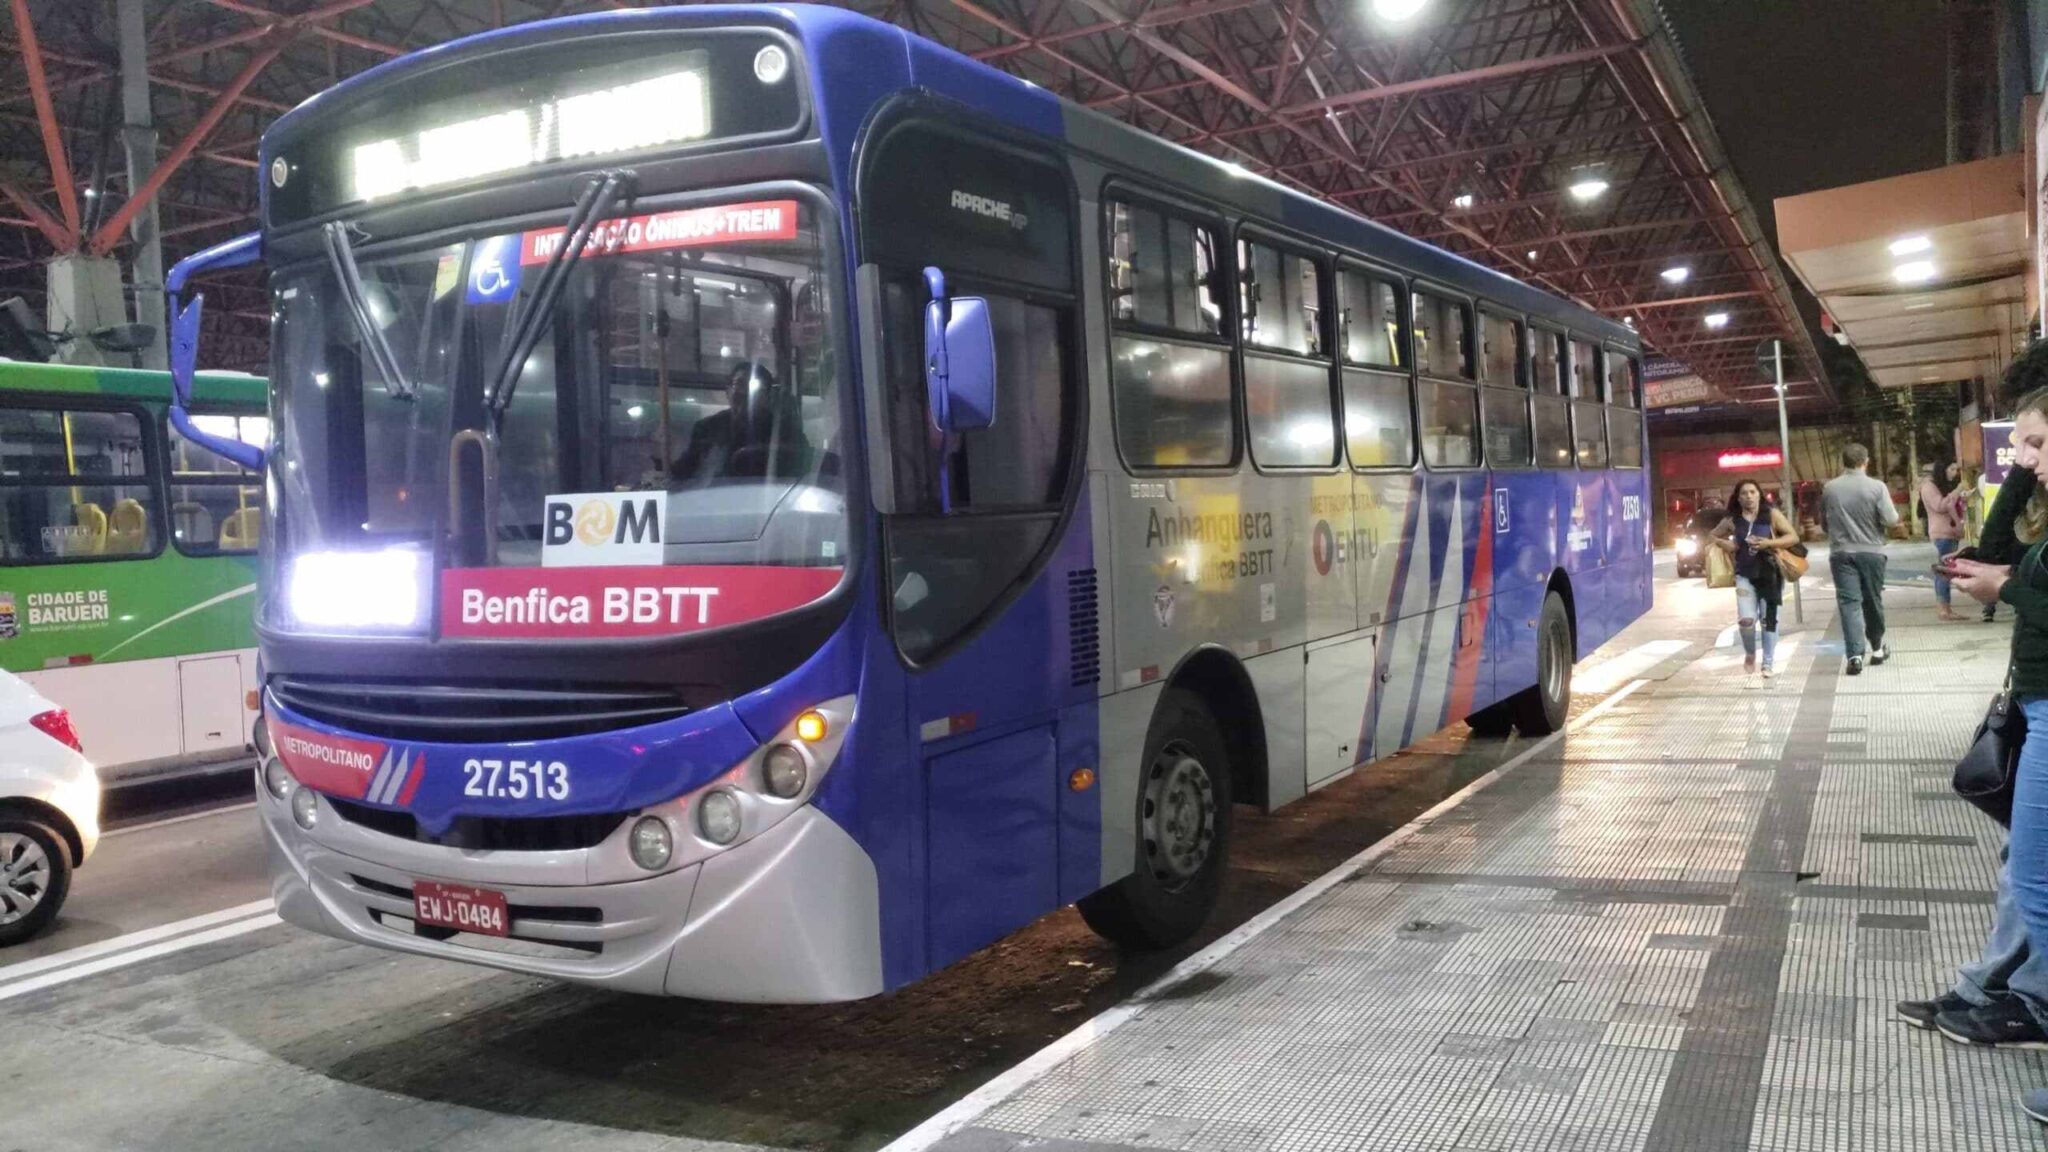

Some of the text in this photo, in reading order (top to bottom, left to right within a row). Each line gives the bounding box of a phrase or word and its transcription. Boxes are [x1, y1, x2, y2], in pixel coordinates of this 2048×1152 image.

[951, 189, 1011, 221] APACHE
[1147, 507, 1273, 552] Anhanguera
[1239, 549, 1274, 578] BBTT
[27, 589, 108, 607] CIDADE DE
[28, 603, 109, 625] BARUERI
[461, 587, 590, 624] Benfica
[602, 586, 720, 624] BBTT
[283, 735, 374, 771] METROPOLITANO
[463, 759, 570, 801] 27.513
[418, 895, 503, 931] EWJ-0484
